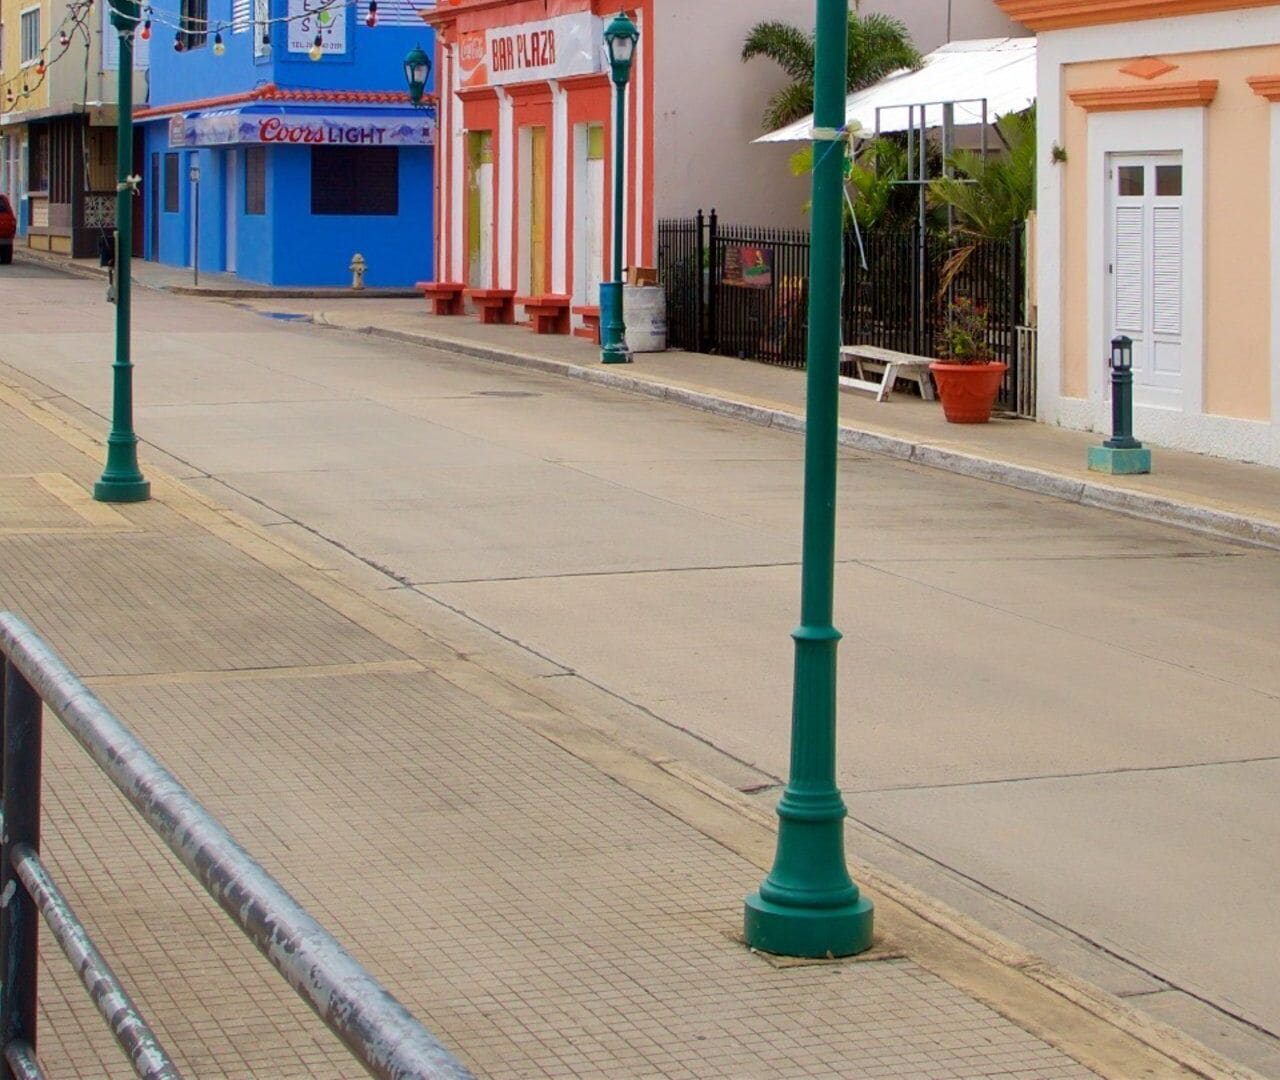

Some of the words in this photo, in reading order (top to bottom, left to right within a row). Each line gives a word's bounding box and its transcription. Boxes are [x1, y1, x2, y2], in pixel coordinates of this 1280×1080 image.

[491, 36, 514, 72] BAR
[516, 29, 556, 69] PLAZA
[259, 117, 325, 143] Coors
[328, 127, 387, 144] LIGHT
